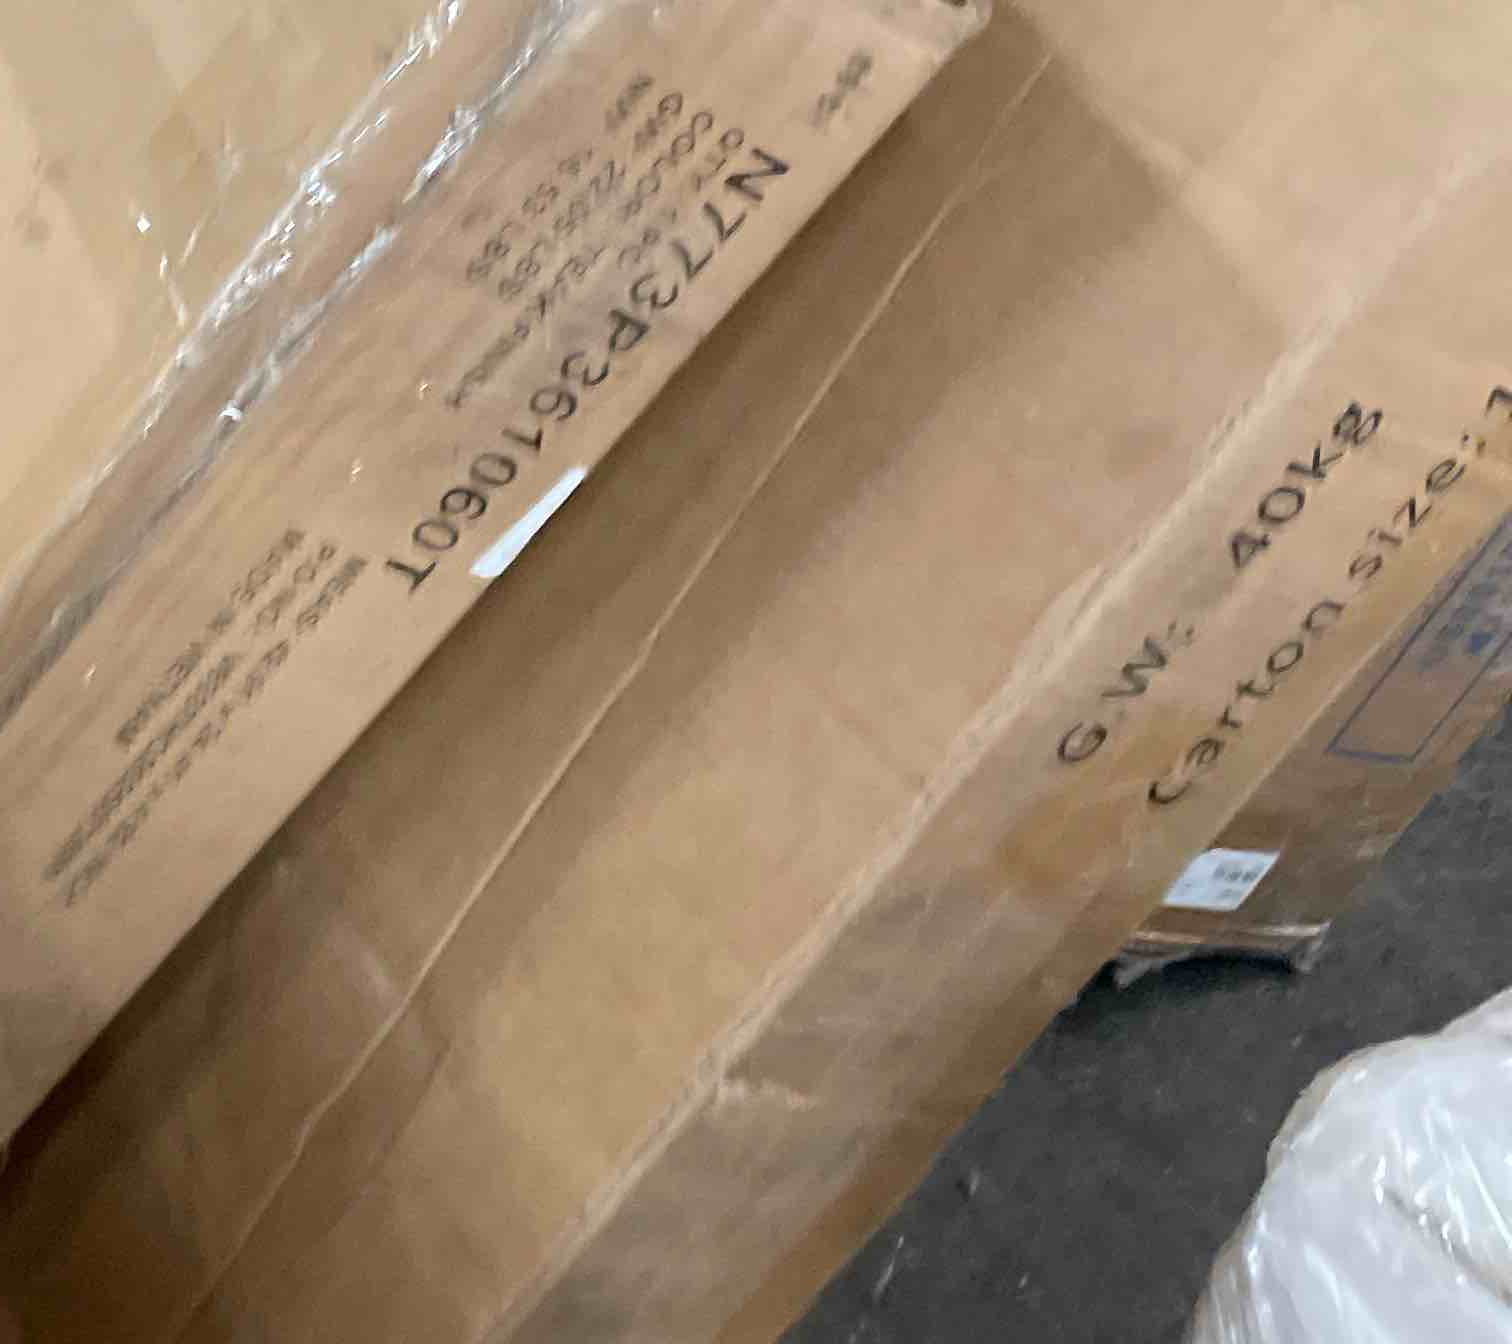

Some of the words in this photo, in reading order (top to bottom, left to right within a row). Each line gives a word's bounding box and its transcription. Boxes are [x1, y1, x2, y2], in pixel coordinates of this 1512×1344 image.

[386, 147, 789, 595] N773P361060T
[1230, 399, 1384, 570] 40kg
[1146, 601, 1345, 806] Carton
